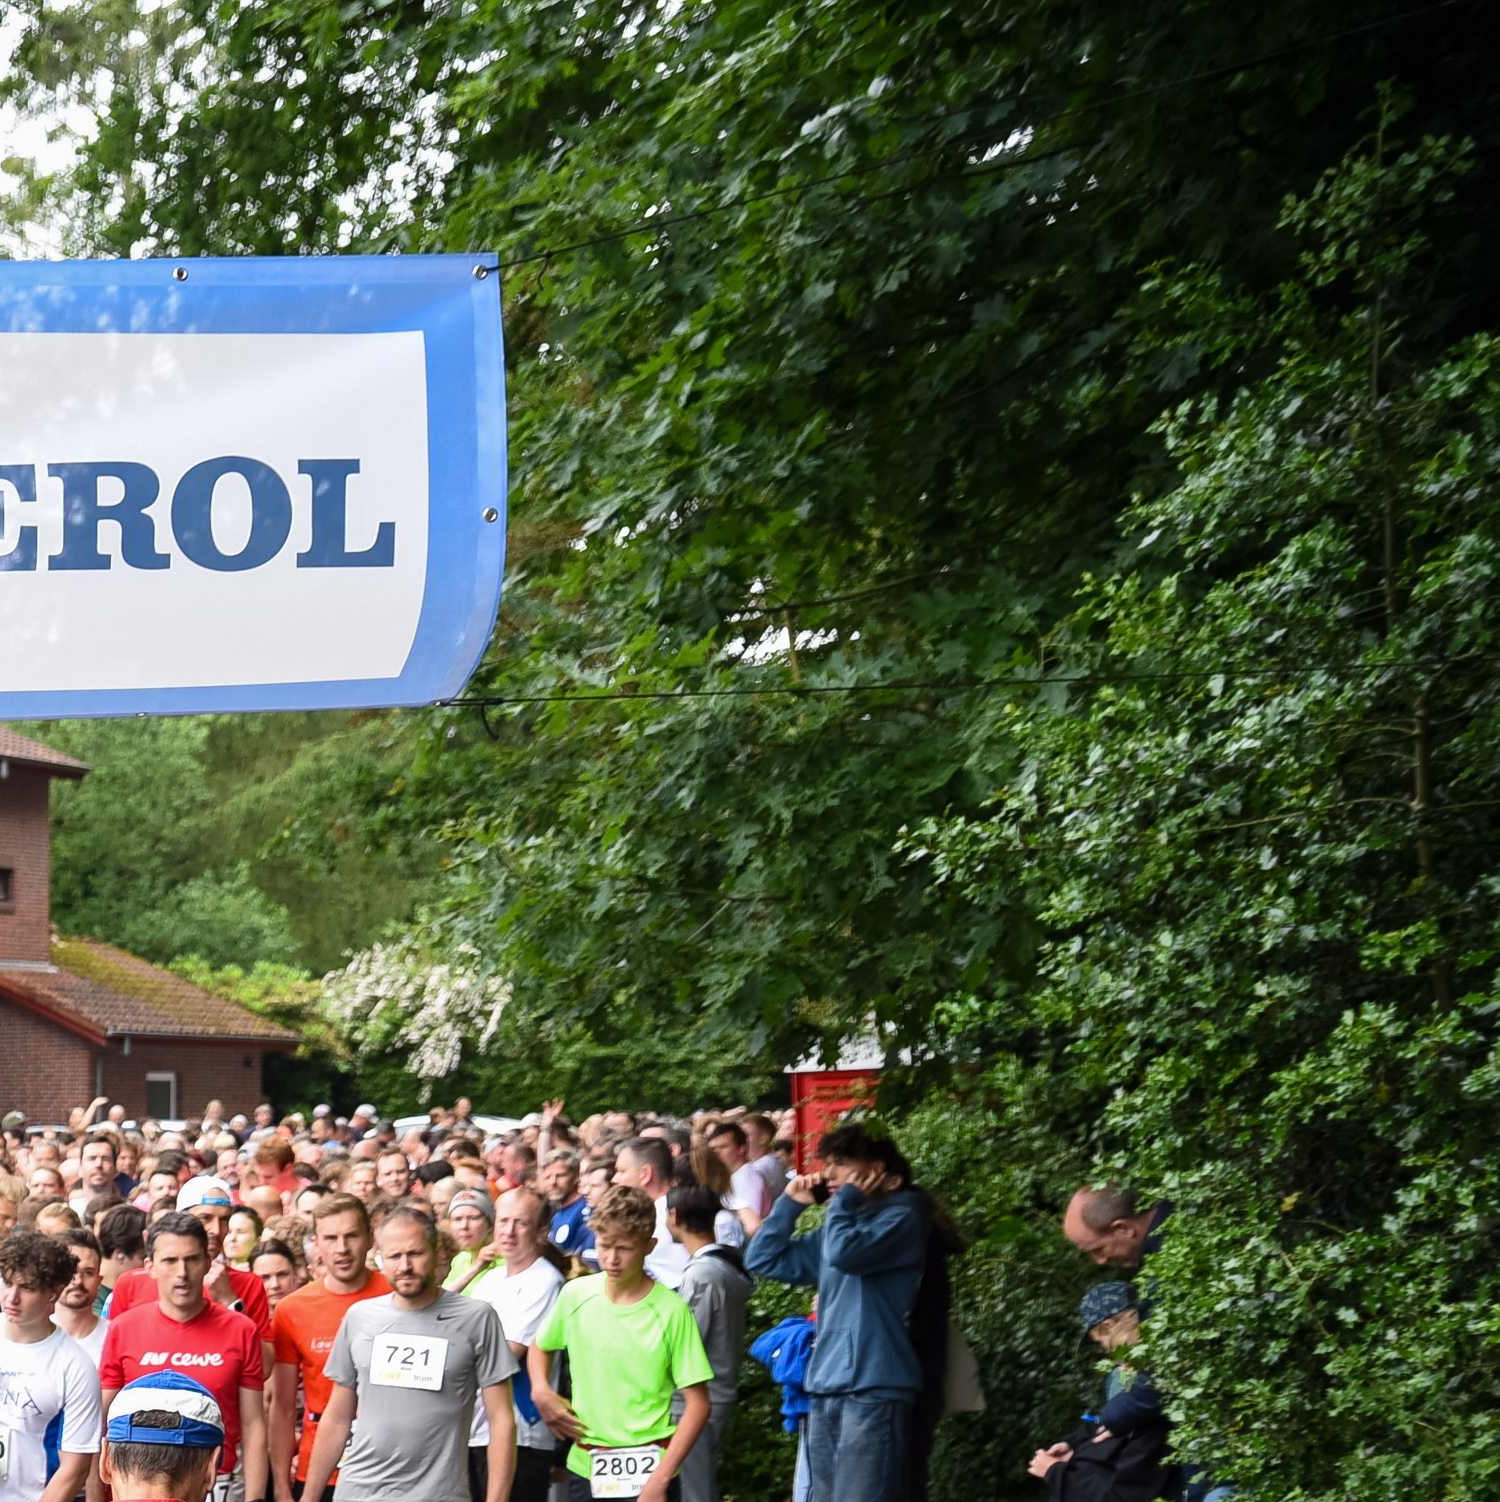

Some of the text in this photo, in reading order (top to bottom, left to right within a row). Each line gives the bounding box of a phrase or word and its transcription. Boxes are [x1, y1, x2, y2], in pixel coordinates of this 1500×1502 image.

[171, 1352, 225, 1366] cewe
[385, 1345, 431, 1367] 721
[594, 1456, 656, 1477] 2802
